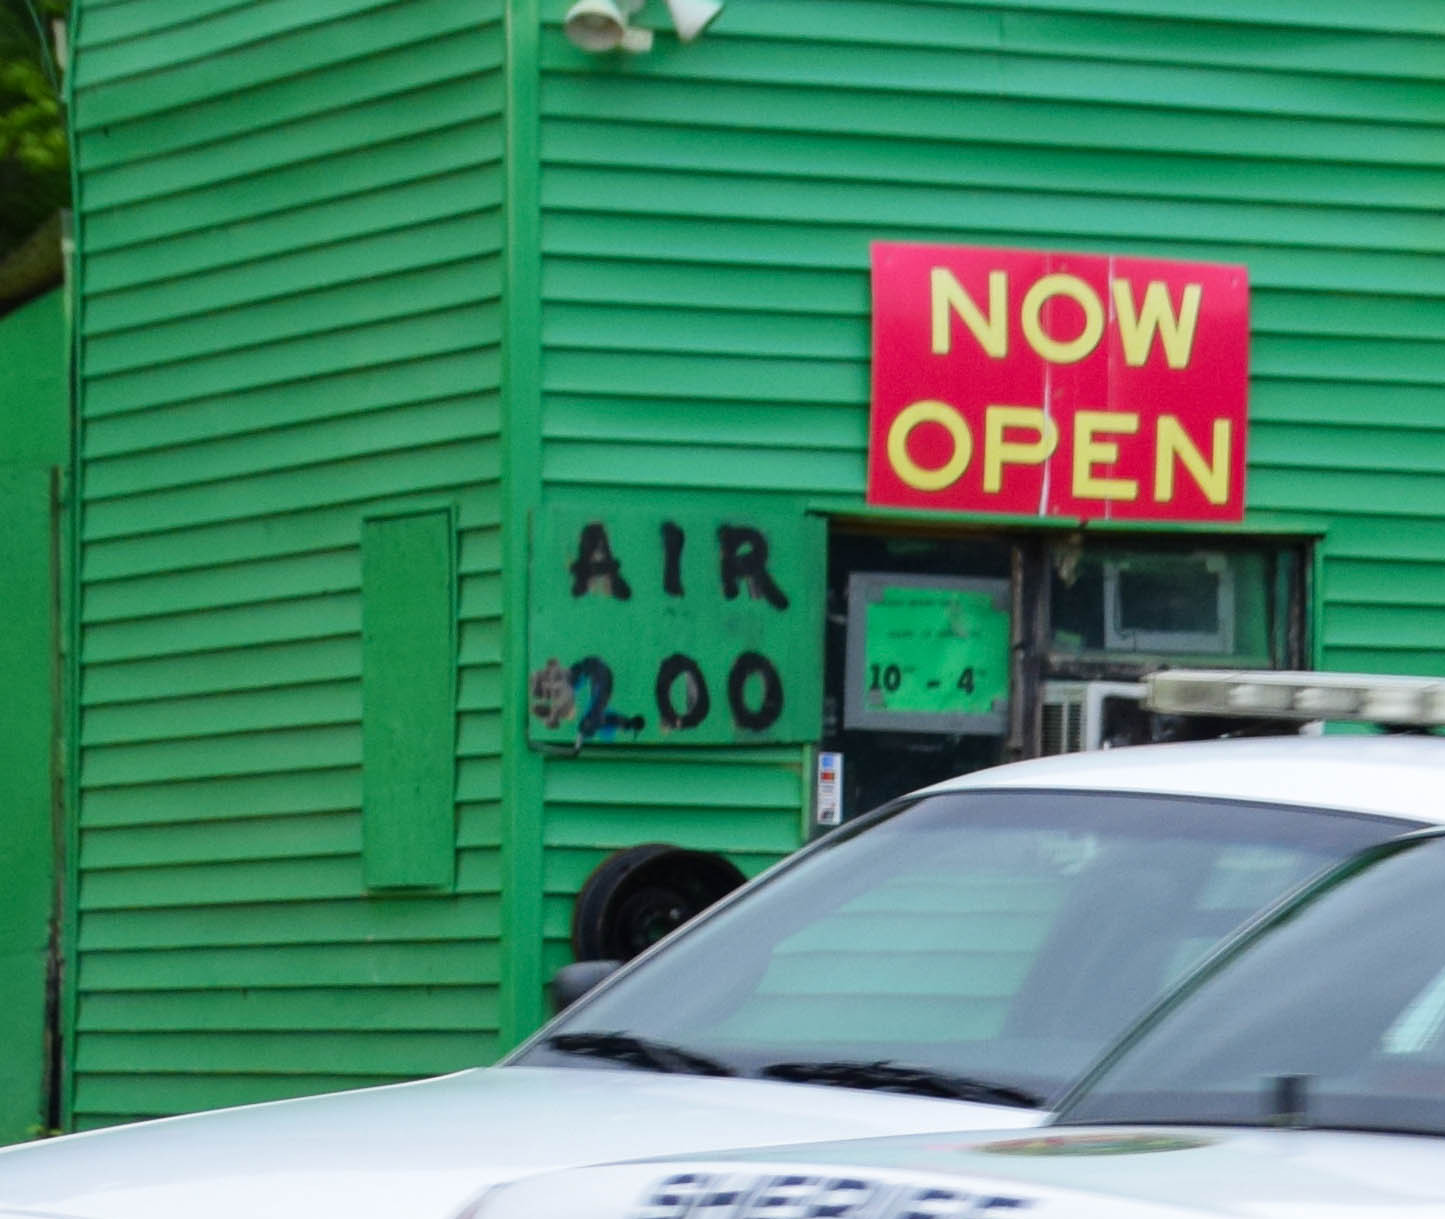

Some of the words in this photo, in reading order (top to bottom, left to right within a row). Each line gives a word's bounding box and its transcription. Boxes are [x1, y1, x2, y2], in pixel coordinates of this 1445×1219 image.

[930, 266, 1201, 369] NOW
[887, 399, 1232, 505] OPEN
[570, 520, 789, 611] AIR
